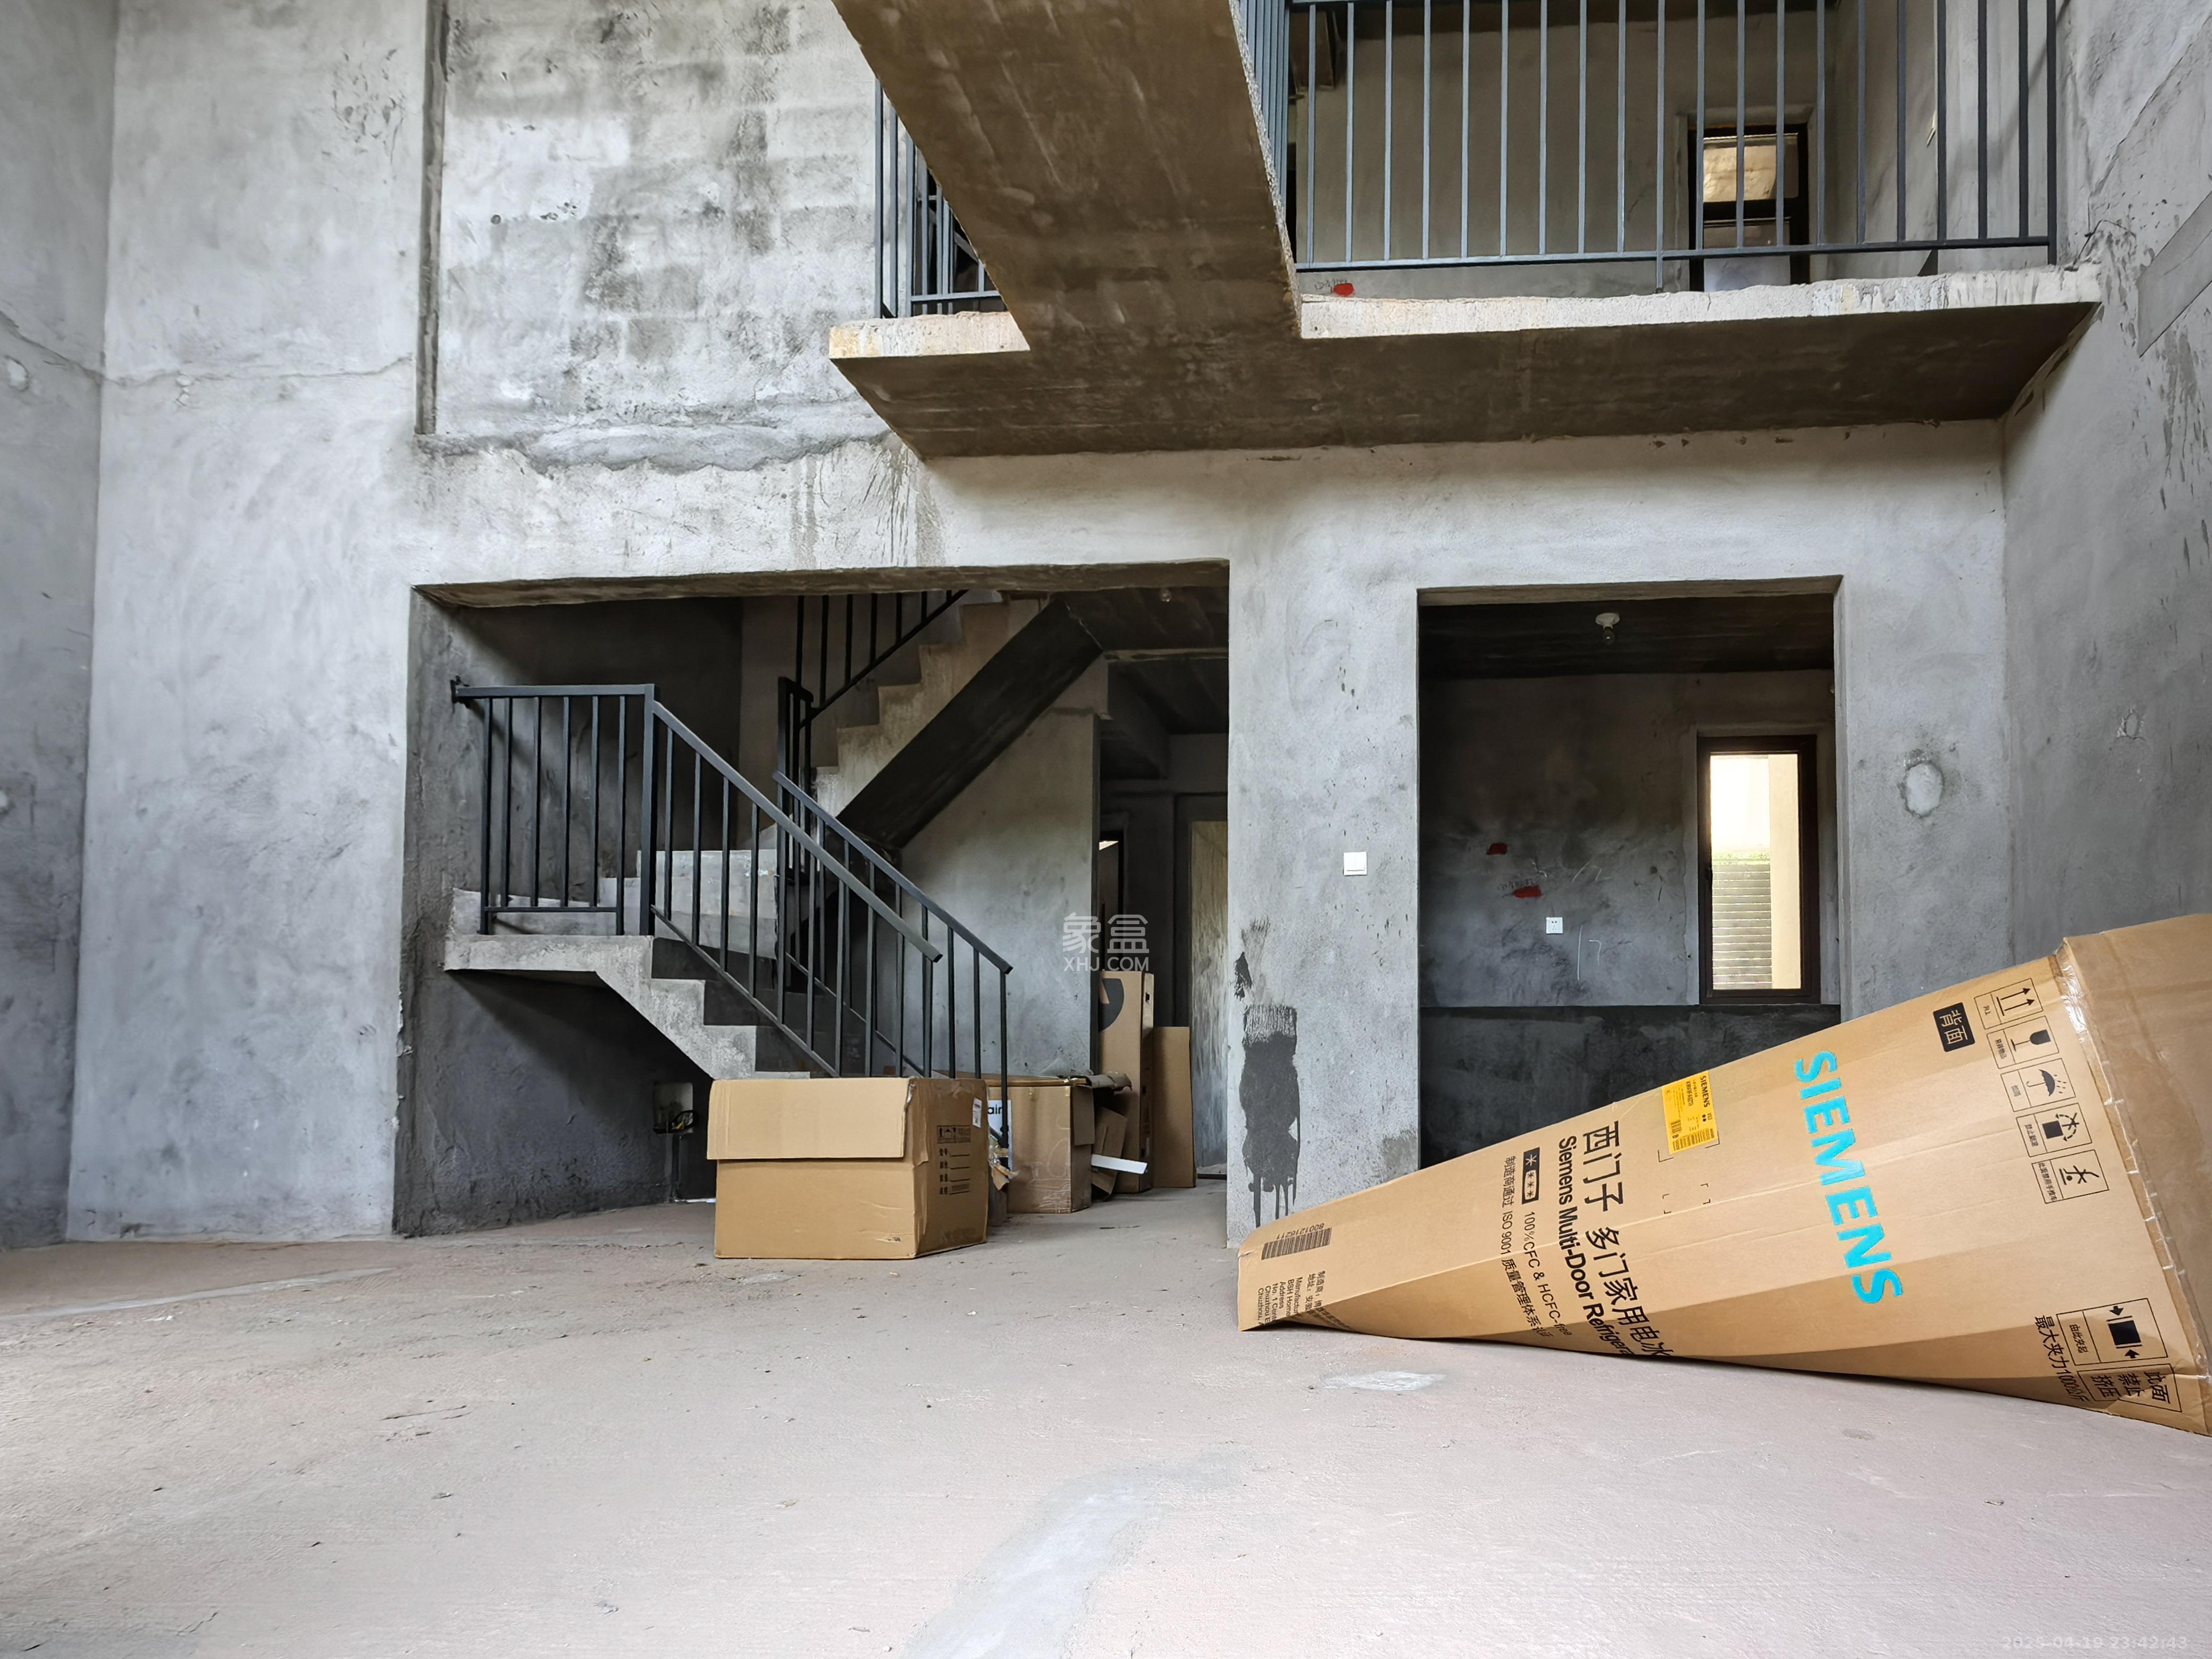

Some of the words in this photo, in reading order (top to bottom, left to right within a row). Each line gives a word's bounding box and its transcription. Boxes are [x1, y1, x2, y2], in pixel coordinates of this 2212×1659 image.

[1939, 1009, 1968, 1044] 背面
[1699, 1075, 1710, 1108] SIEMENS
[1502, 1156, 1516, 1208] 制造商通过
[1559, 1135, 1577, 1205] Siemens
[1582, 1121, 1624, 1212] 西门子
[1794, 1050, 1904, 1304] SIEMENS
[1502, 1211, 1513, 1229] ISO
[1501, 1230, 1513, 1255] 9001
[1559, 1206, 1594, 1300] Multi-Door
[1533, 1271, 1545, 1281] &
[1537, 1284, 1572, 1336] HCFC-free
[2069, 1323, 2089, 1354] 由此夹起
[2090, 1375, 2123, 1398] 挤压
[2118, 1372, 2145, 1397] 禁止
[2144, 1371, 2171, 1404] 此面
